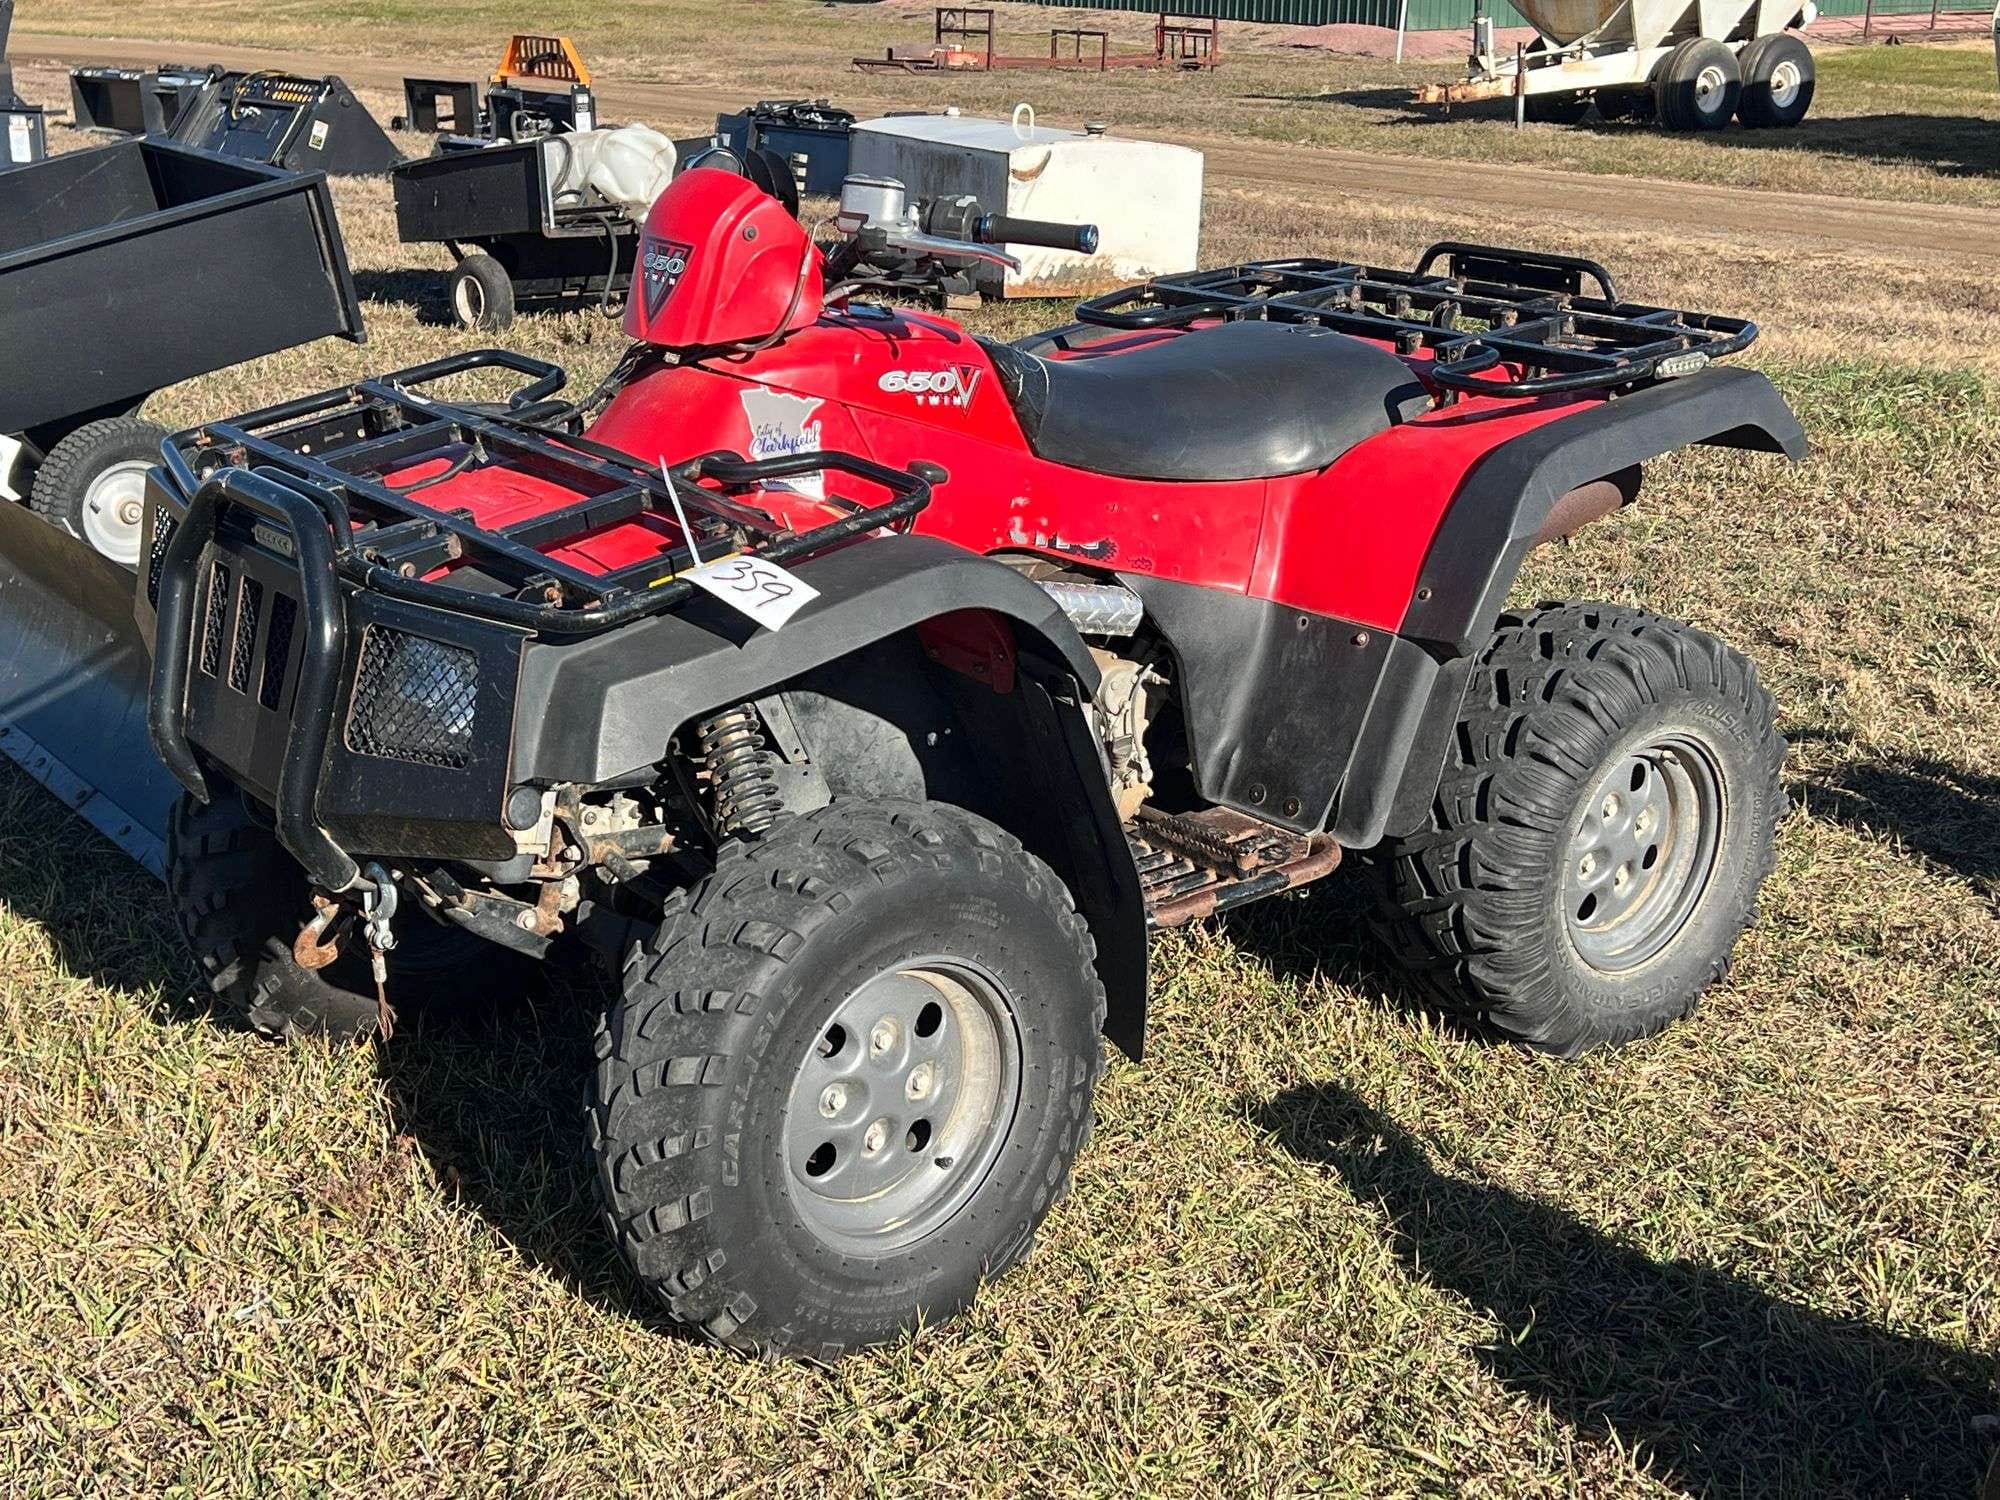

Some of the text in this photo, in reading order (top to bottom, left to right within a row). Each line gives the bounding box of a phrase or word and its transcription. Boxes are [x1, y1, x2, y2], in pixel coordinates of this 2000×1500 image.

[643, 252, 685, 274] 650
[644, 271, 677, 286] TWIN
[915, 395, 962, 406] TWIN
[752, 423, 818, 456] Clarkfield
[757, 423, 773, 440] City
[711, 561, 793, 608] 359
[721, 974, 802, 1187] CARLISLE
